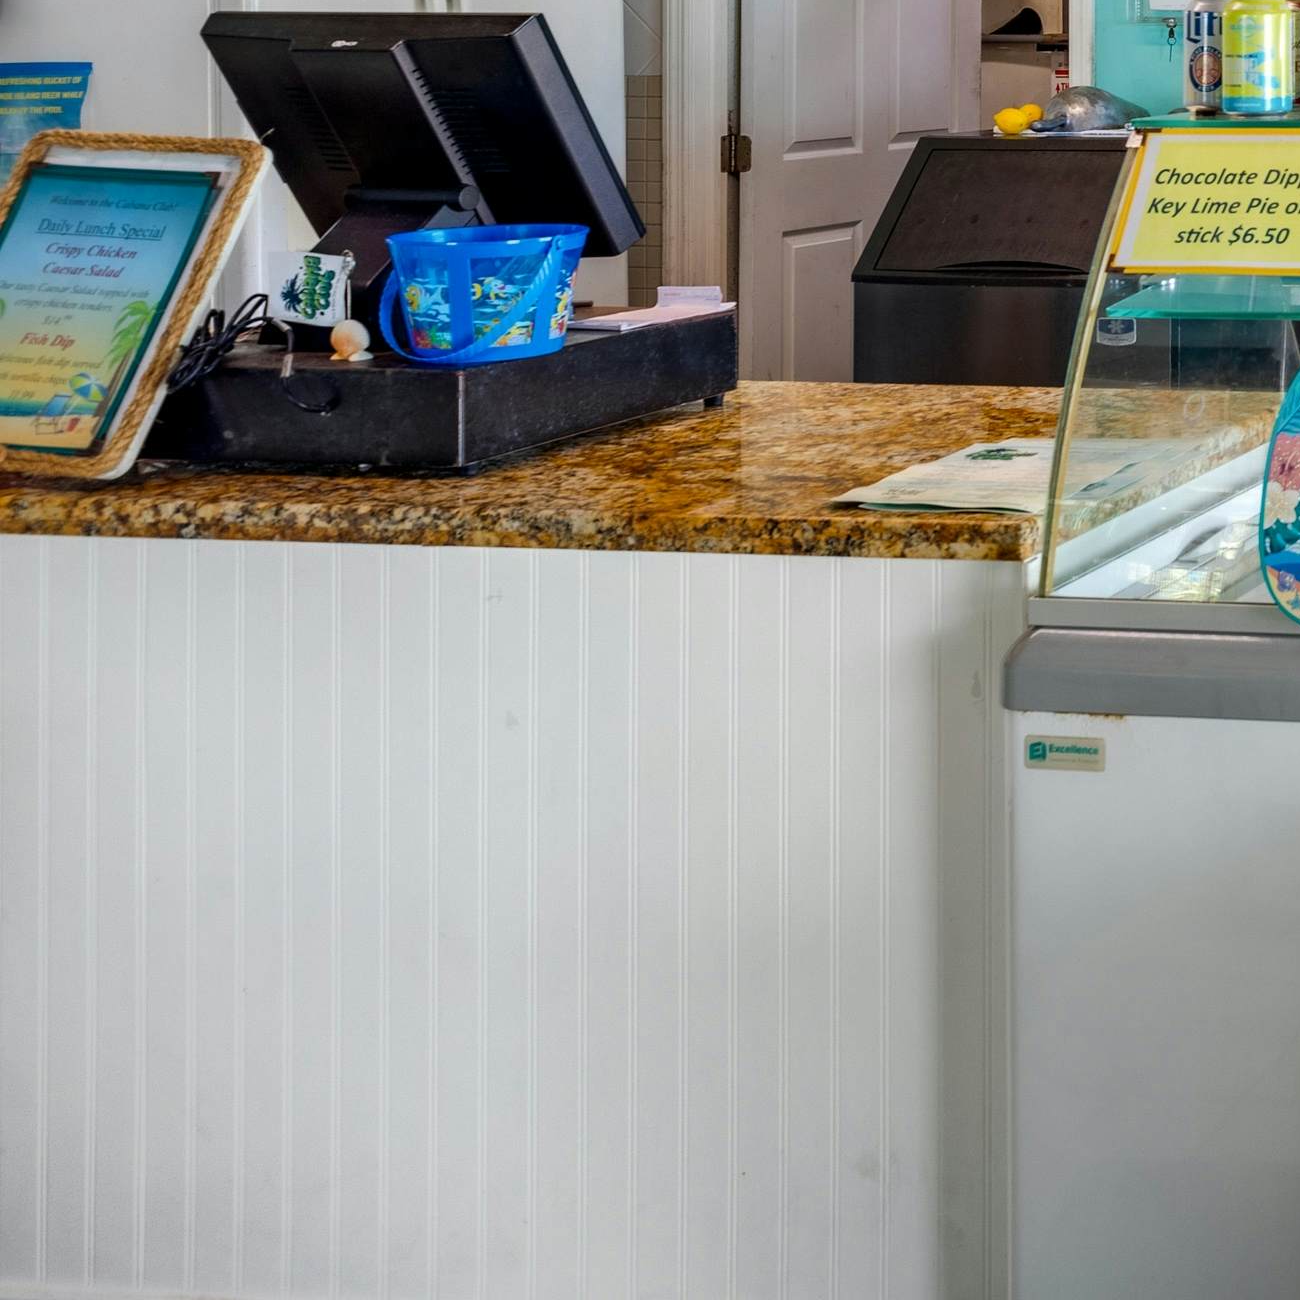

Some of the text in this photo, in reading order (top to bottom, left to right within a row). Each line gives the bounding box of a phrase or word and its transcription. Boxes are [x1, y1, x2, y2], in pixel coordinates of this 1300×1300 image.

[1155, 168, 1258, 185] Chocolate
[1148, 197, 1186, 217] Key
[1191, 197, 1240, 214] Lime
[1246, 197, 1277, 214] Pie
[38, 218, 167, 238] Daily Lunch Special
[1175, 225, 1290, 245] stick $6.50
[46, 242, 137, 260] Crispy Chicken
[43, 262, 122, 278] Caesar Salad
[20, 332, 75, 349] Fish Dip
